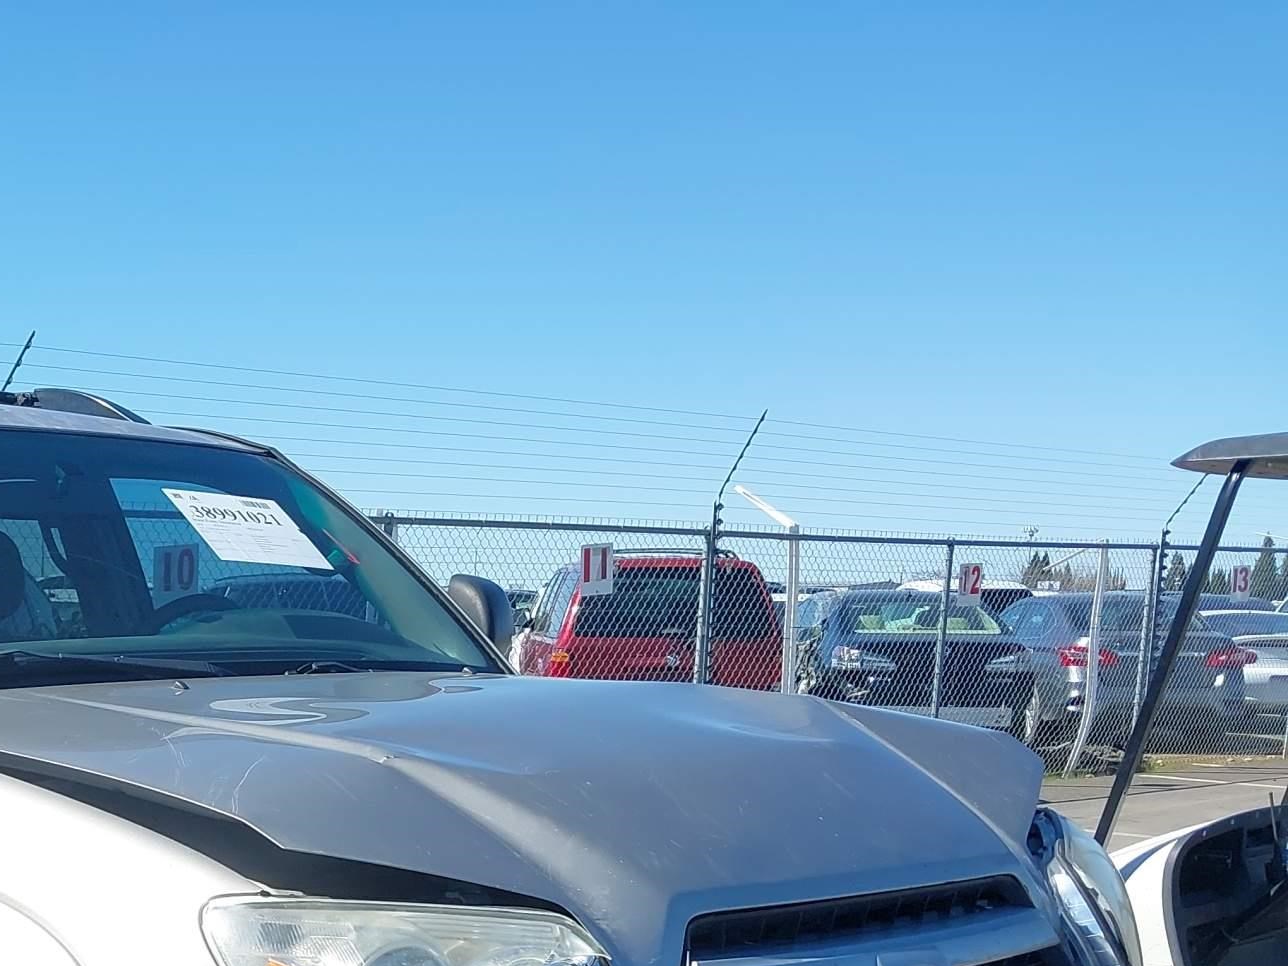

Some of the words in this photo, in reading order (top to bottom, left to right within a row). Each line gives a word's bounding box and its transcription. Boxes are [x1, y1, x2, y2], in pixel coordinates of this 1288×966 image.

[189, 504, 283, 527] 38991021
[163, 548, 195, 592] 10
[583, 547, 608, 583] 11
[962, 565, 982, 596] 12
[1231, 565, 1251, 594] 13
